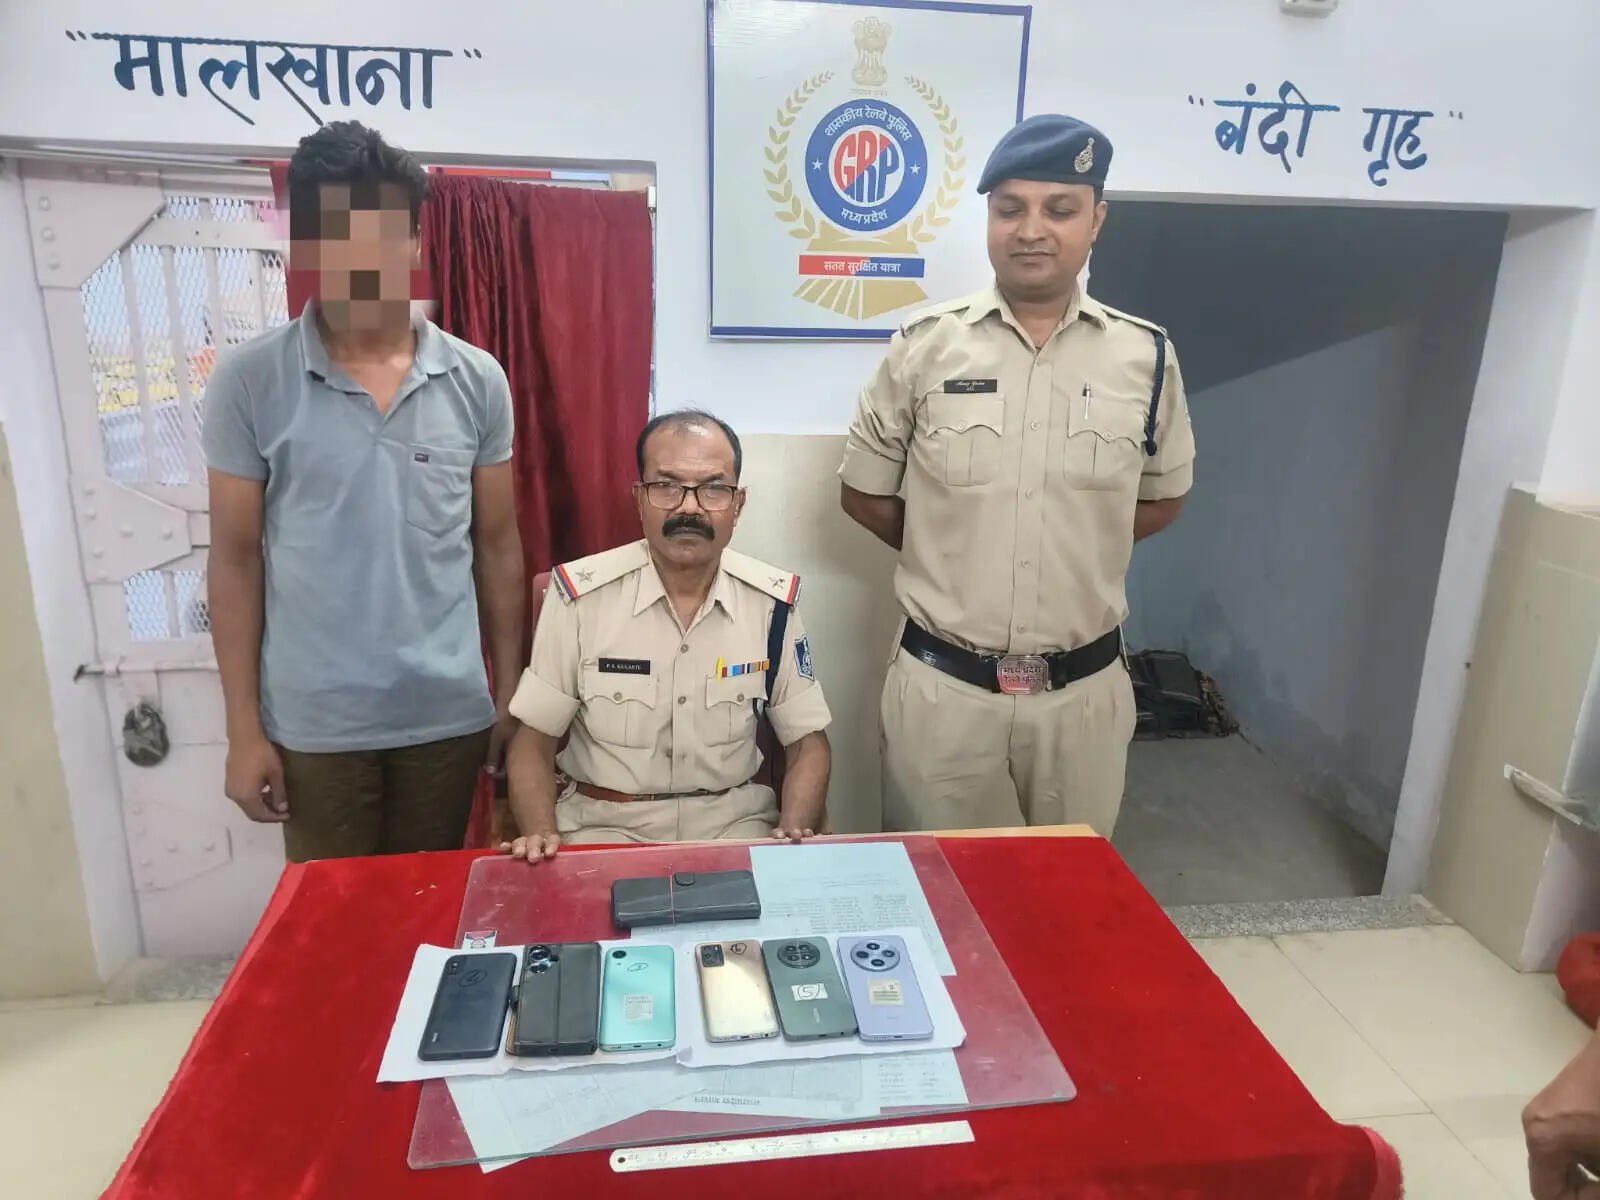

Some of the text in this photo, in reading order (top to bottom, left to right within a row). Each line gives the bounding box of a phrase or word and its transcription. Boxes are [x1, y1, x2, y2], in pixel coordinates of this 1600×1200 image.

[824, 104, 912, 141] शासकीय रेलवे पुलिस
[834, 130, 900, 203] GRP
[824, 260, 901, 273] सतत सुरक्षित यात्रा
